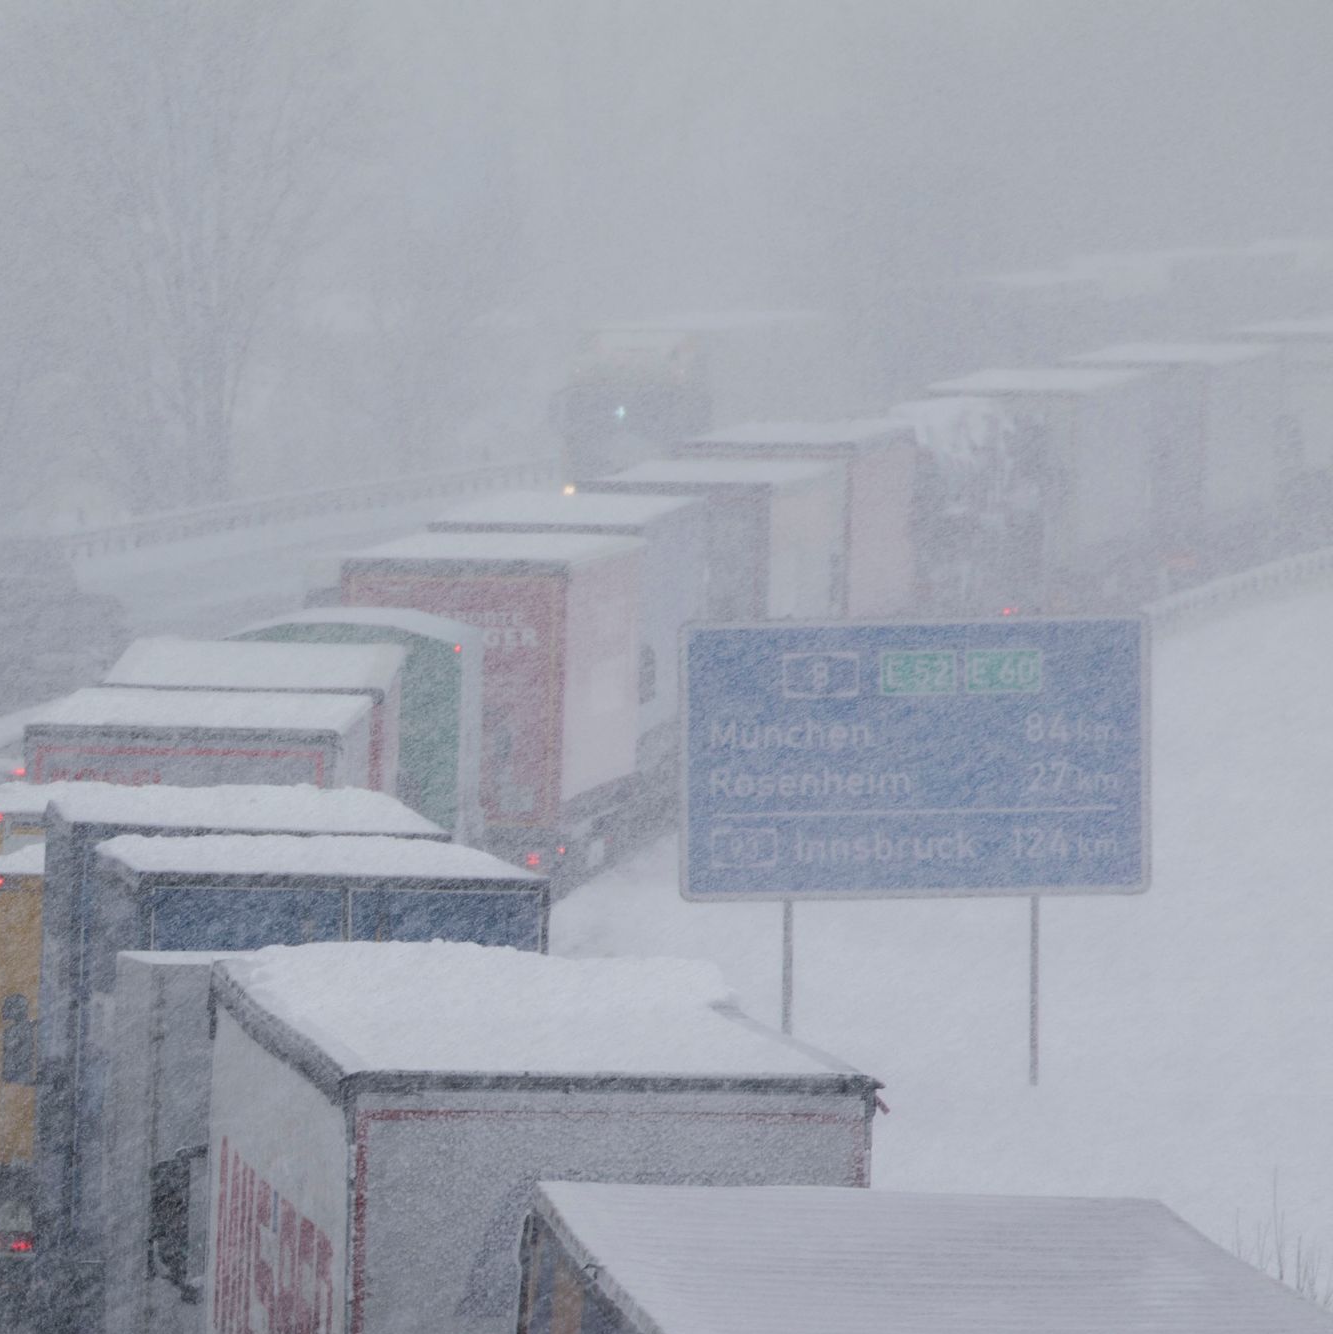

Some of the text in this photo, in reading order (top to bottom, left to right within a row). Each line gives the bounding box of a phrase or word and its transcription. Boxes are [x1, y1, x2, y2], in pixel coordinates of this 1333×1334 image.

[811, 661, 829, 688] 8
[914, 658, 950, 687] 52
[999, 657, 1036, 685] 60
[1024, 712, 1070, 744] 84
[708, 766, 912, 798] Rosenheim
[1023, 762, 1070, 795] 27
[794, 829, 979, 862] Innsbruck
[1013, 826, 1070, 860] 124
